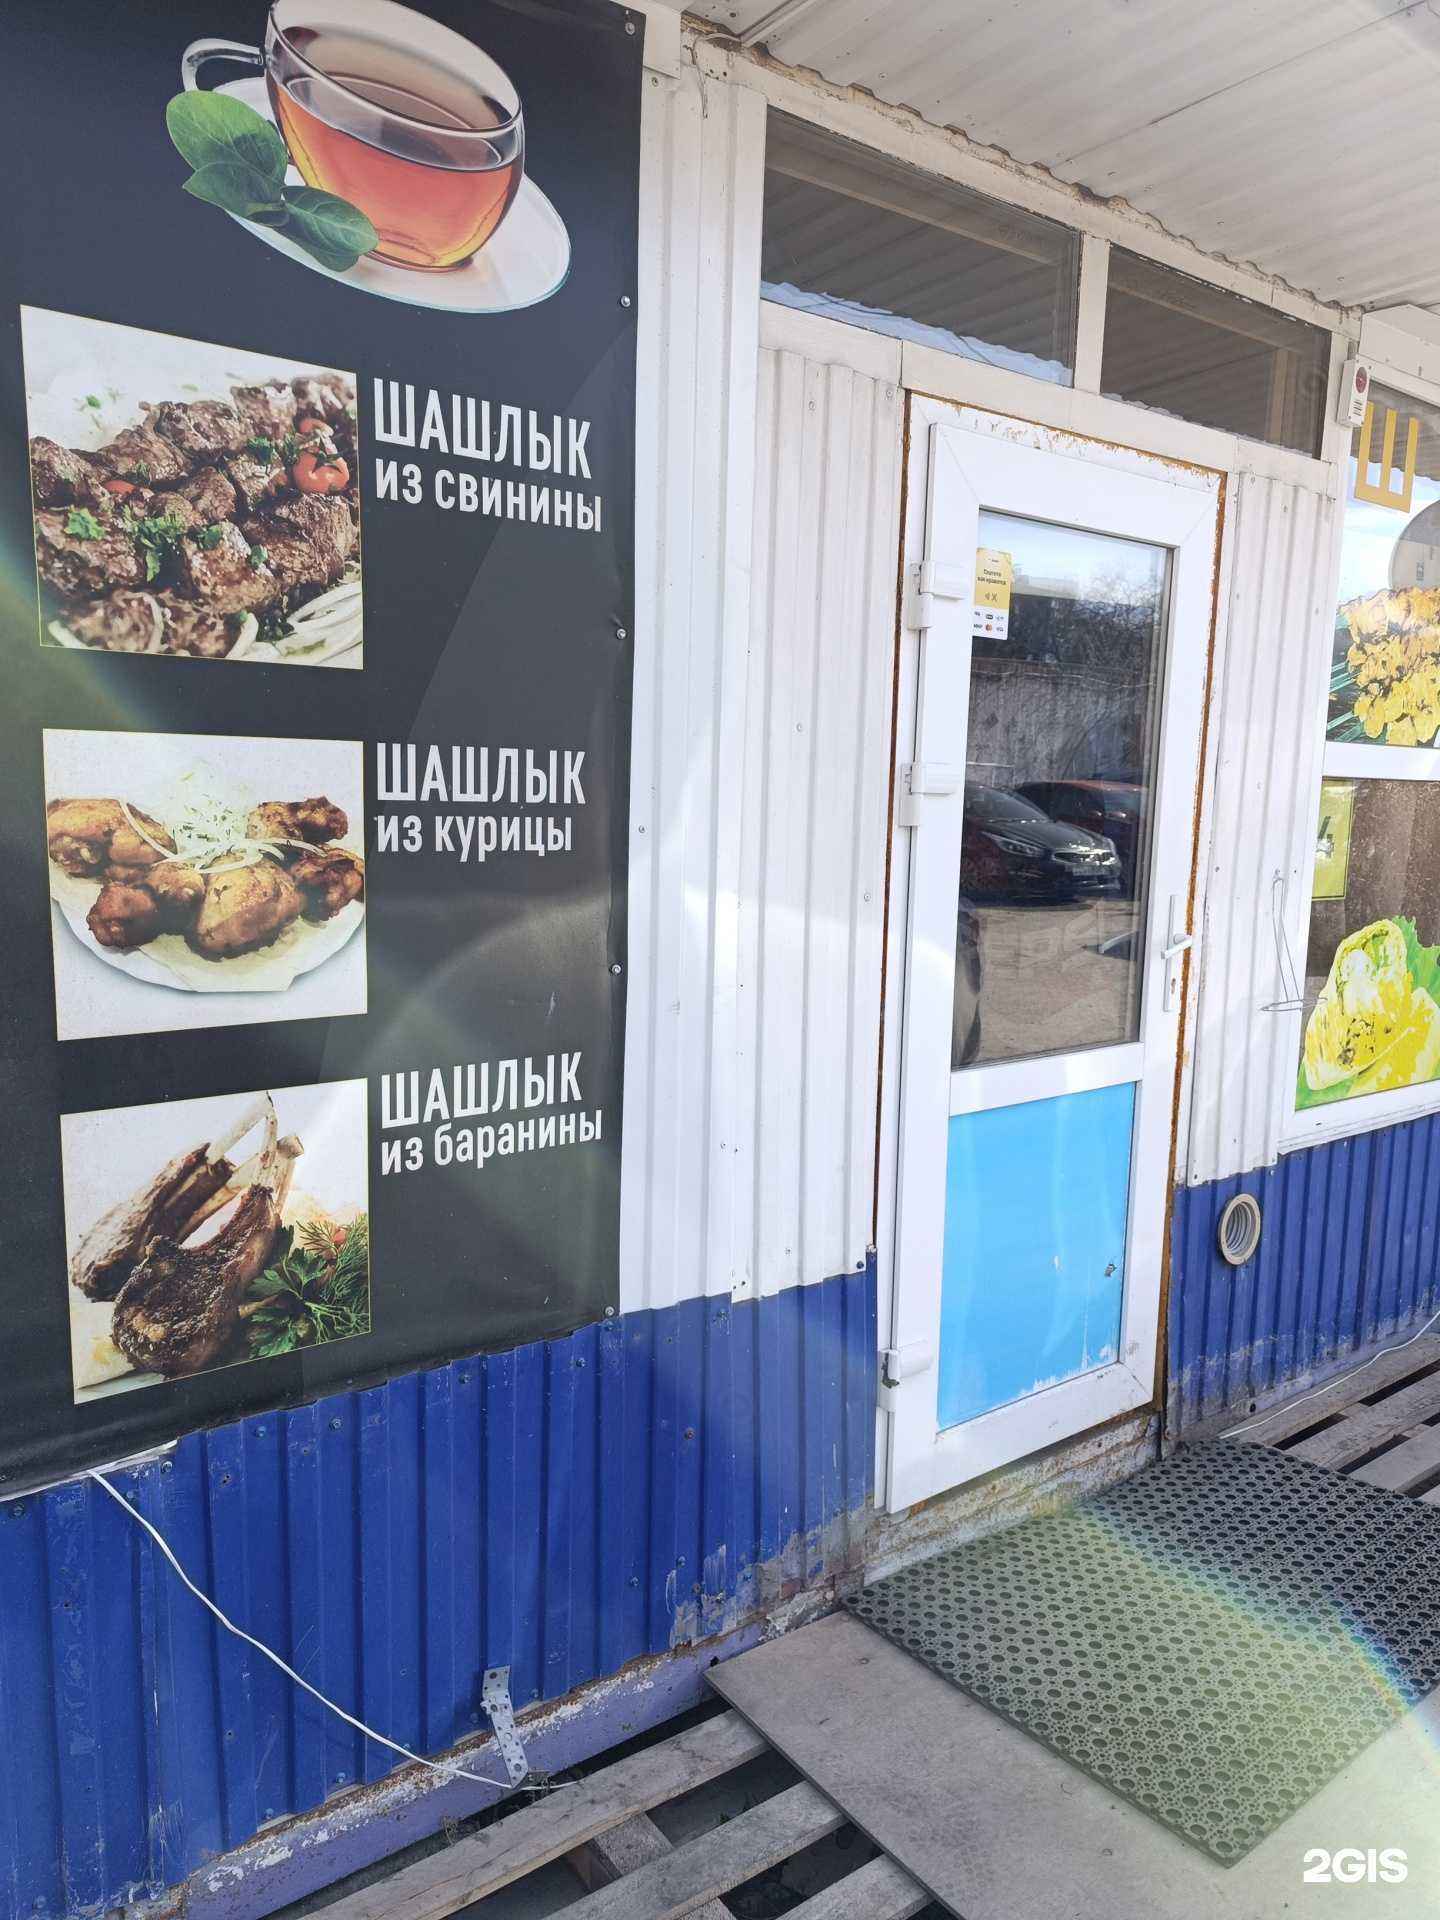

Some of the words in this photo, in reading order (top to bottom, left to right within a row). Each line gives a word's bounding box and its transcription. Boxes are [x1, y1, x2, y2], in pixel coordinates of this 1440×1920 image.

[374, 377, 592, 479] ШАШЛЫК
[377, 742, 586, 804] ШАШЛЫК
[377, 815, 423, 852] из
[435, 815, 572, 862] курицы
[381, 1051, 583, 1129] ШАШЛЫК
[381, 1136, 424, 1176] из
[434, 1109, 602, 1169] баранины
